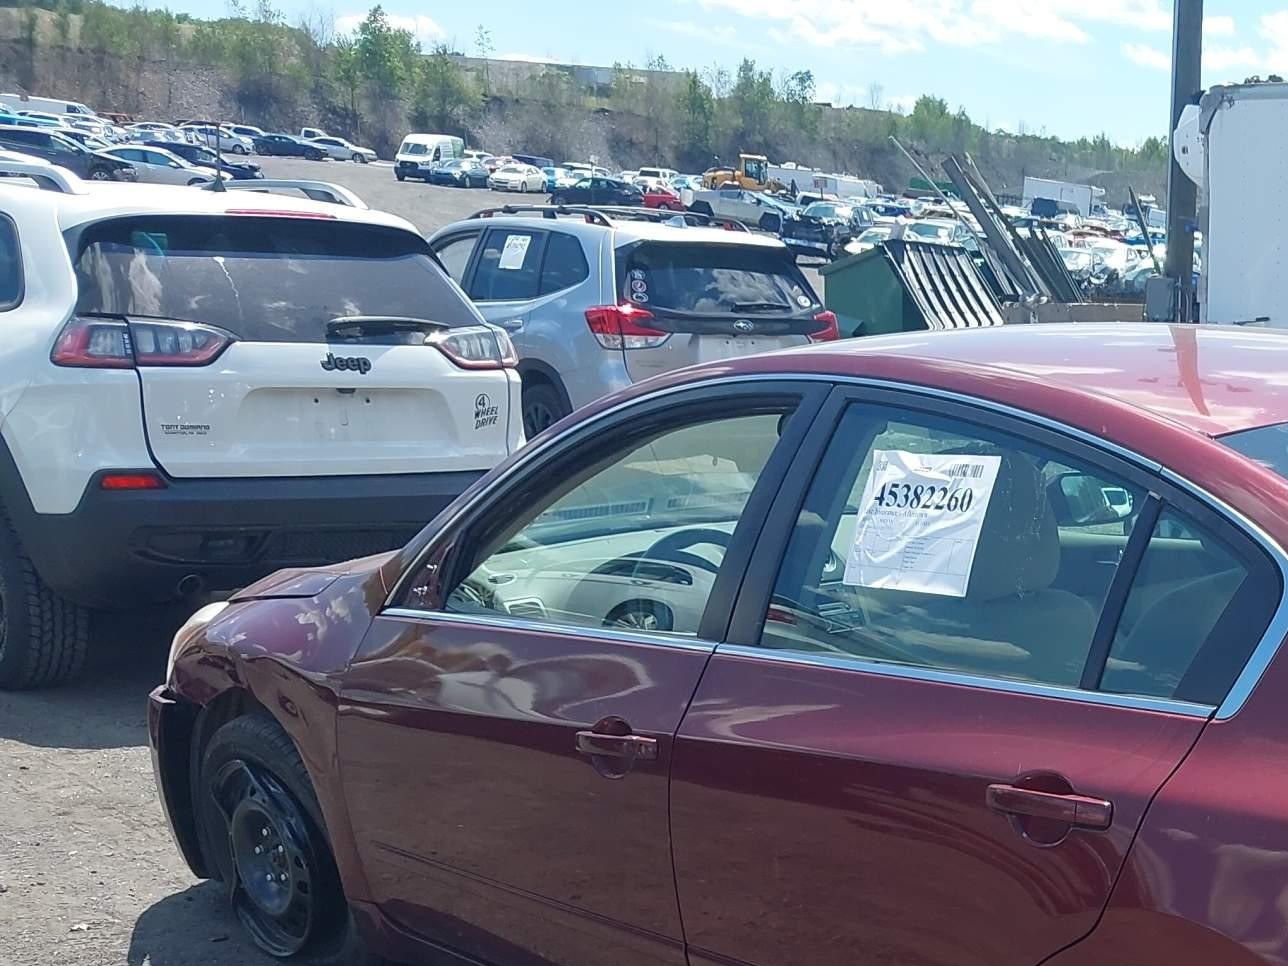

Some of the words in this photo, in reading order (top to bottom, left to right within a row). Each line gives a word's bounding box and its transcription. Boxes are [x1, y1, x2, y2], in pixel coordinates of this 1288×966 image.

[320, 352, 371, 374] Jeep
[475, 406, 498, 419] WHEEL
[475, 416, 498, 429] DRIVE
[874, 482, 973, 512] 45382260
